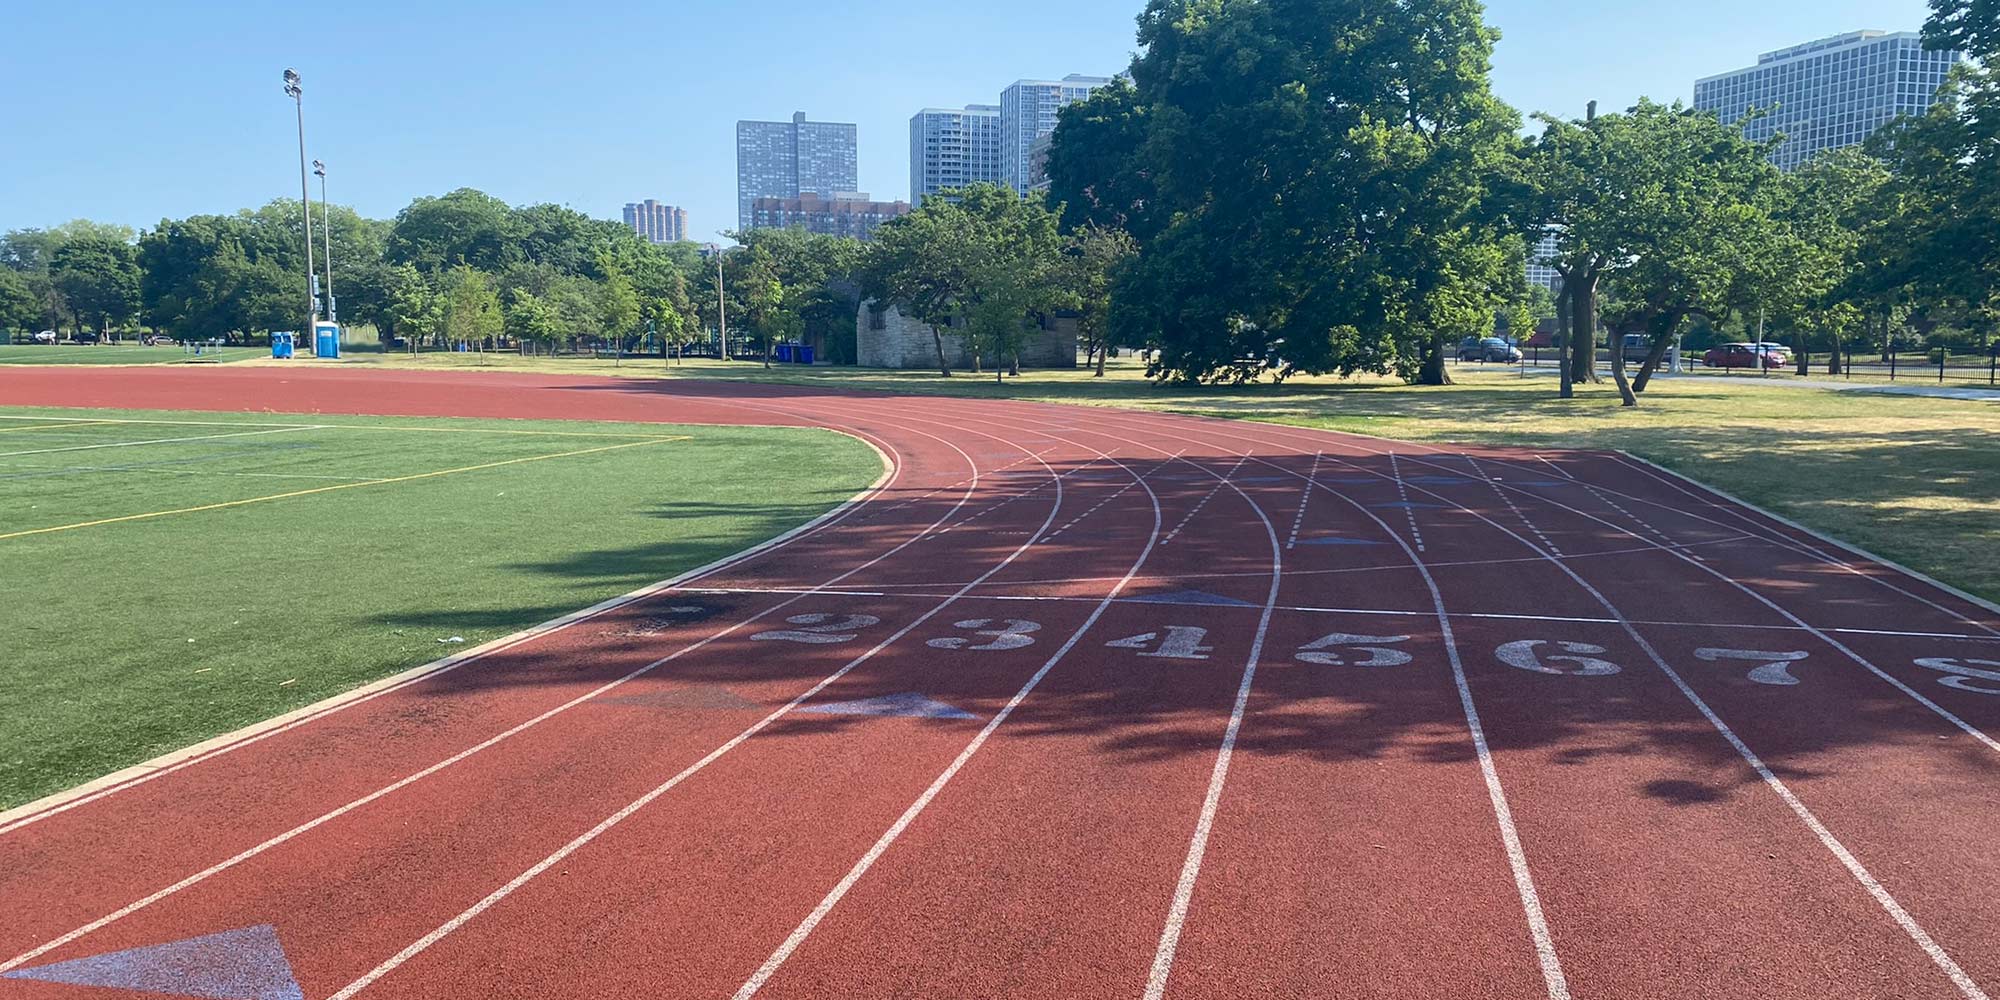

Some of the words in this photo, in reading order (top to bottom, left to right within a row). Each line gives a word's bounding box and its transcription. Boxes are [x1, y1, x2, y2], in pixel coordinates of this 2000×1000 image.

[750, 613, 881, 645] 2
[925, 618, 1042, 651] 3
[1105, 625, 1213, 660] 4
[1295, 632, 1412, 667] 5
[1495, 639, 1621, 676] 6
[1694, 647, 1809, 686] 7
